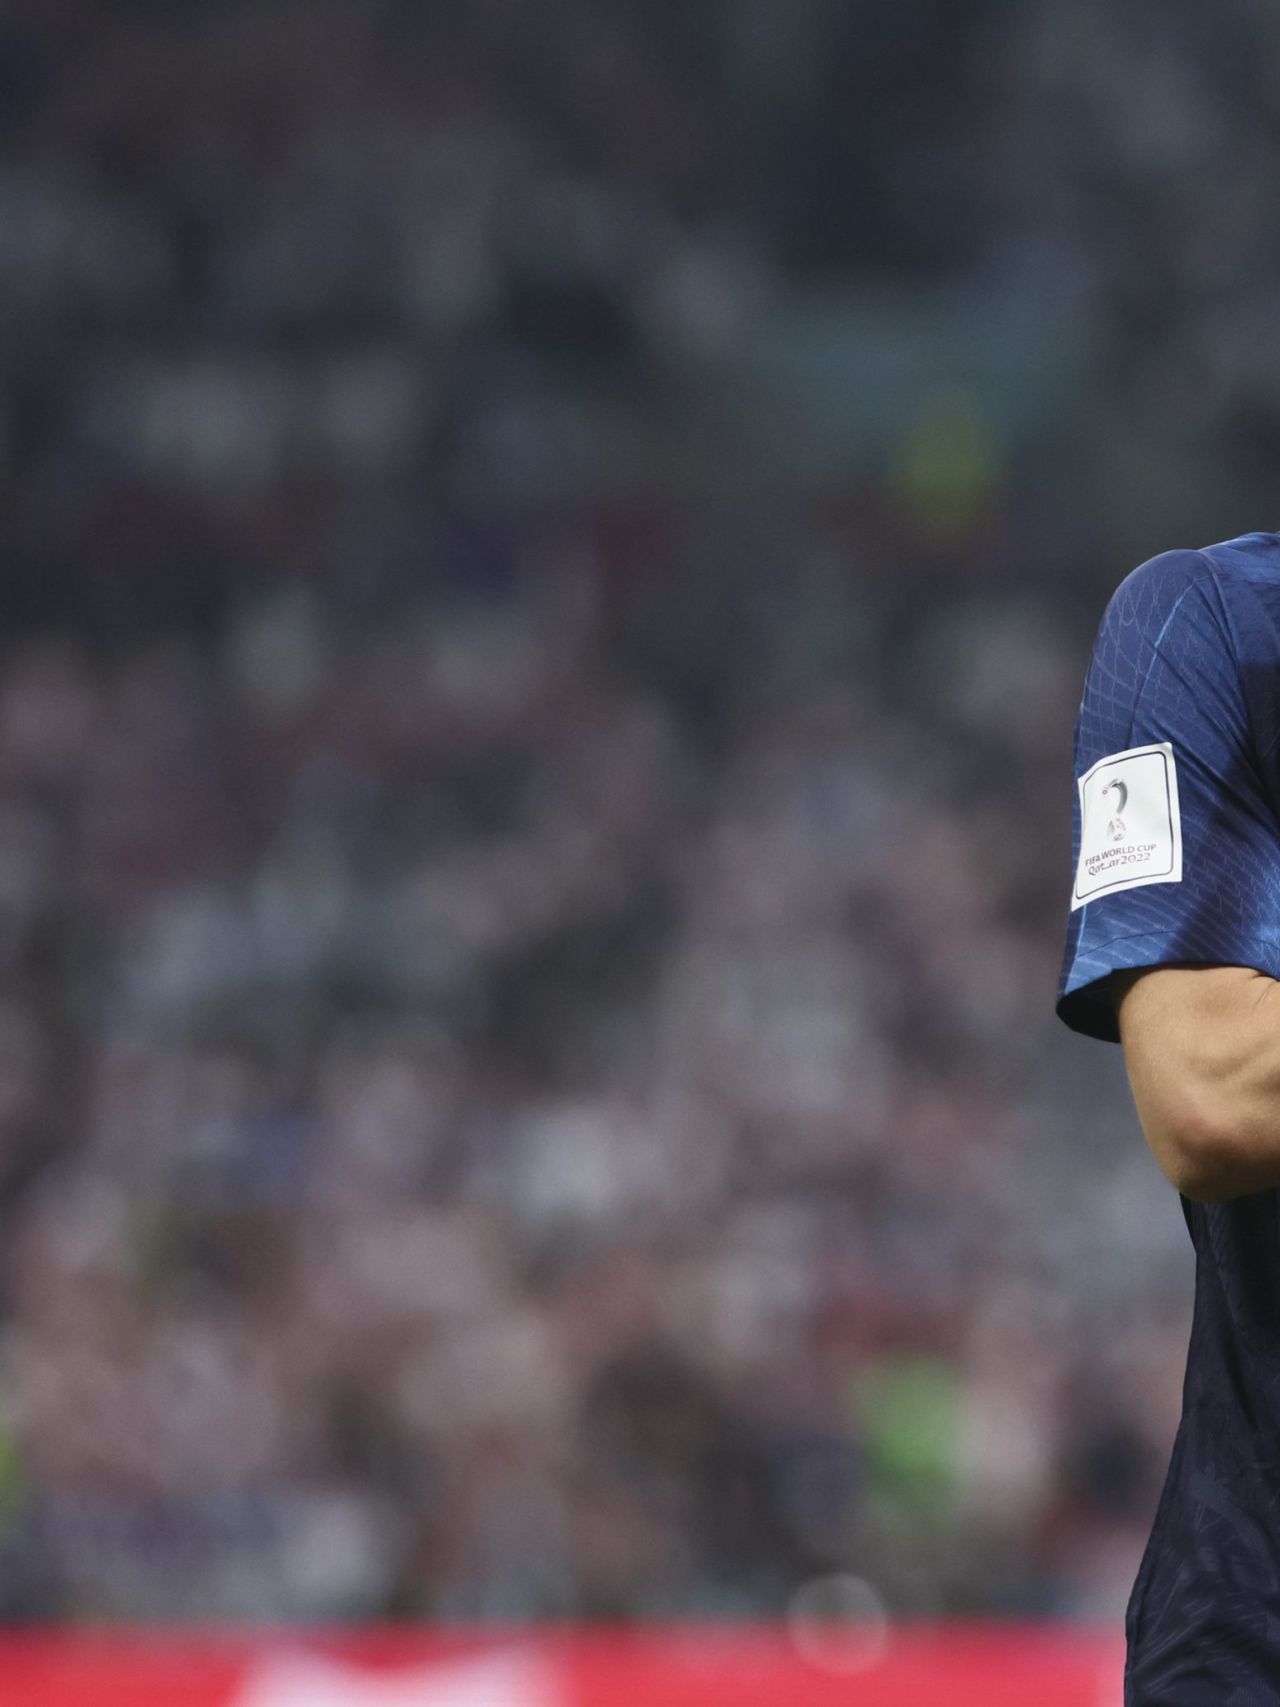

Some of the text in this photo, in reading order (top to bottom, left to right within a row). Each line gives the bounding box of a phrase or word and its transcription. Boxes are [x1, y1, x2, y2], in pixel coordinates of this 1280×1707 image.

[1084, 844, 1157, 867] FIFA WORLD CUP
